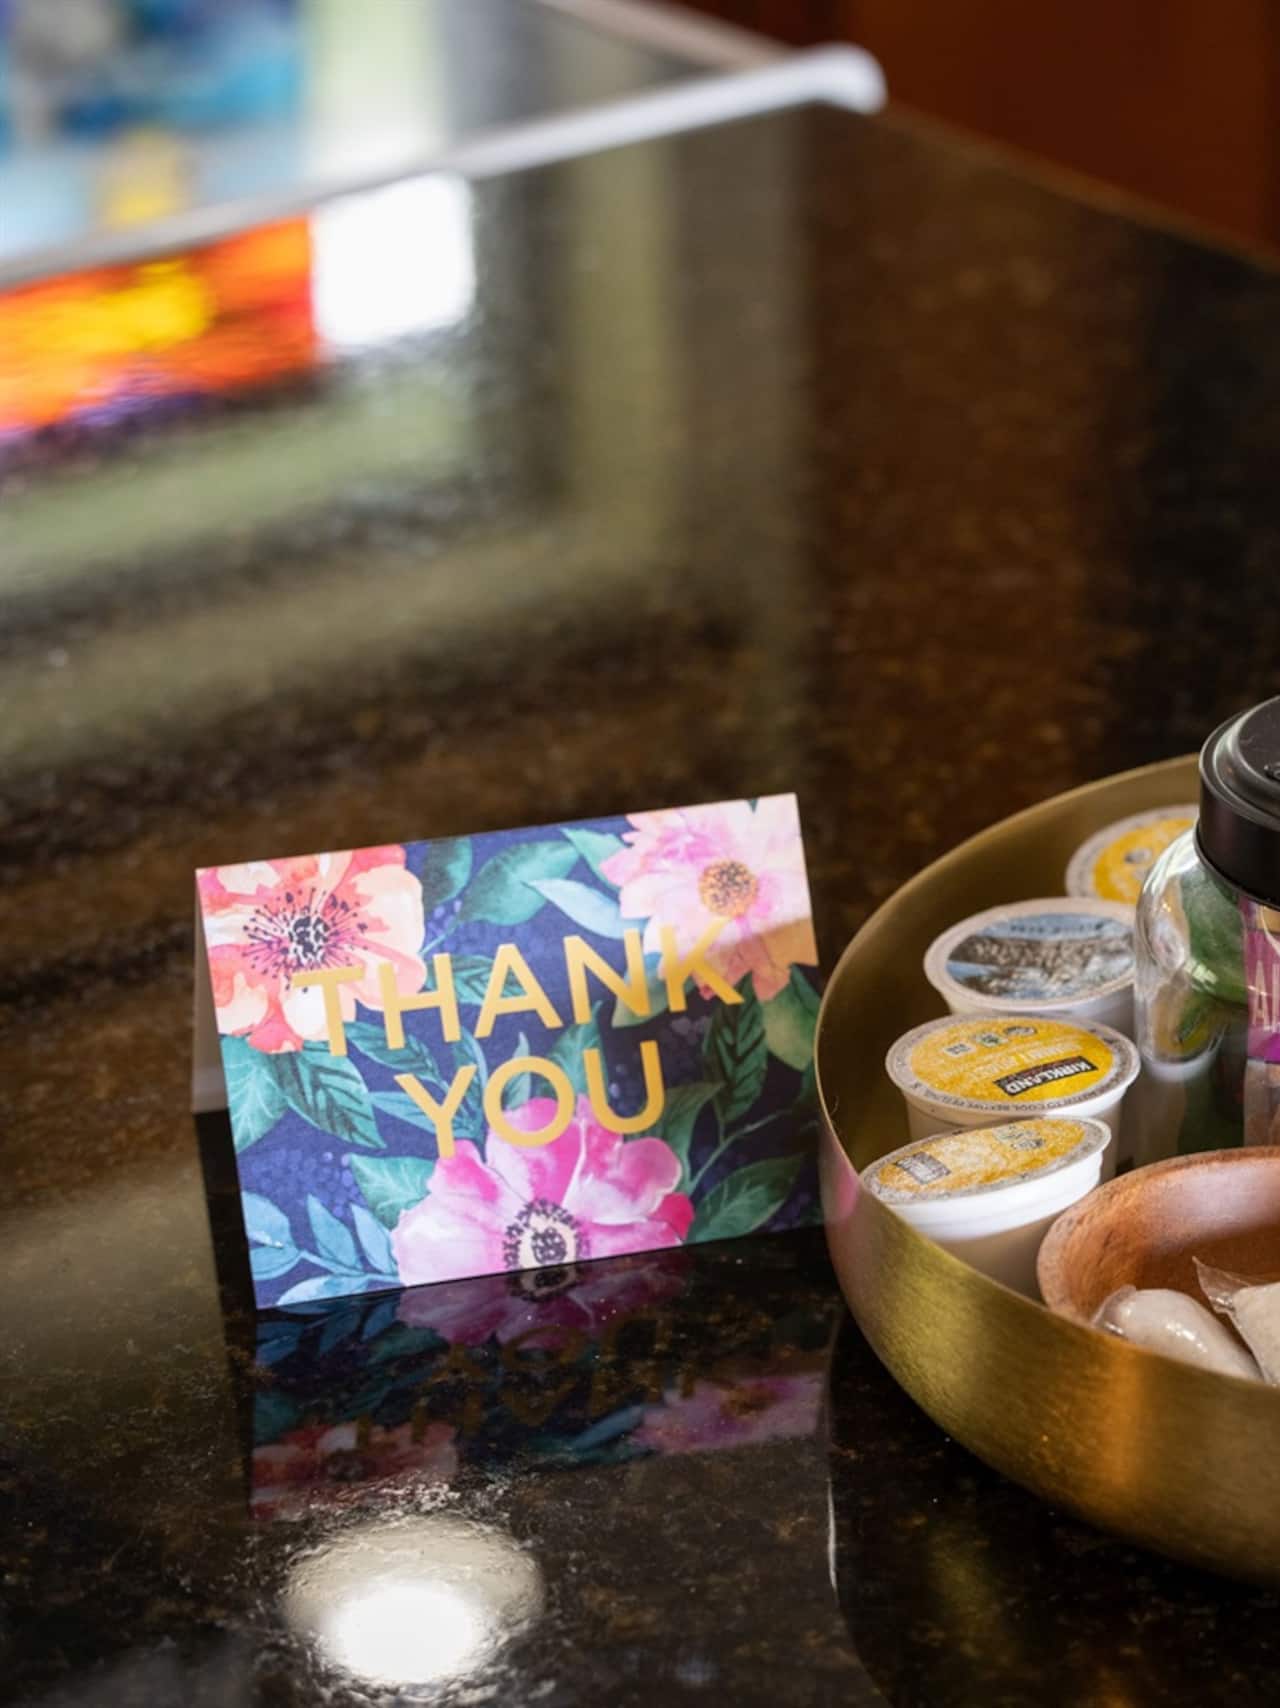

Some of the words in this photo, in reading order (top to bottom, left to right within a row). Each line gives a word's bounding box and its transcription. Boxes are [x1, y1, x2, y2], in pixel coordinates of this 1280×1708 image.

[292, 916, 746, 1057] THANK
[394, 1040, 666, 1159] YOU
[1004, 1060, 1092, 1094] KIRKLAND
